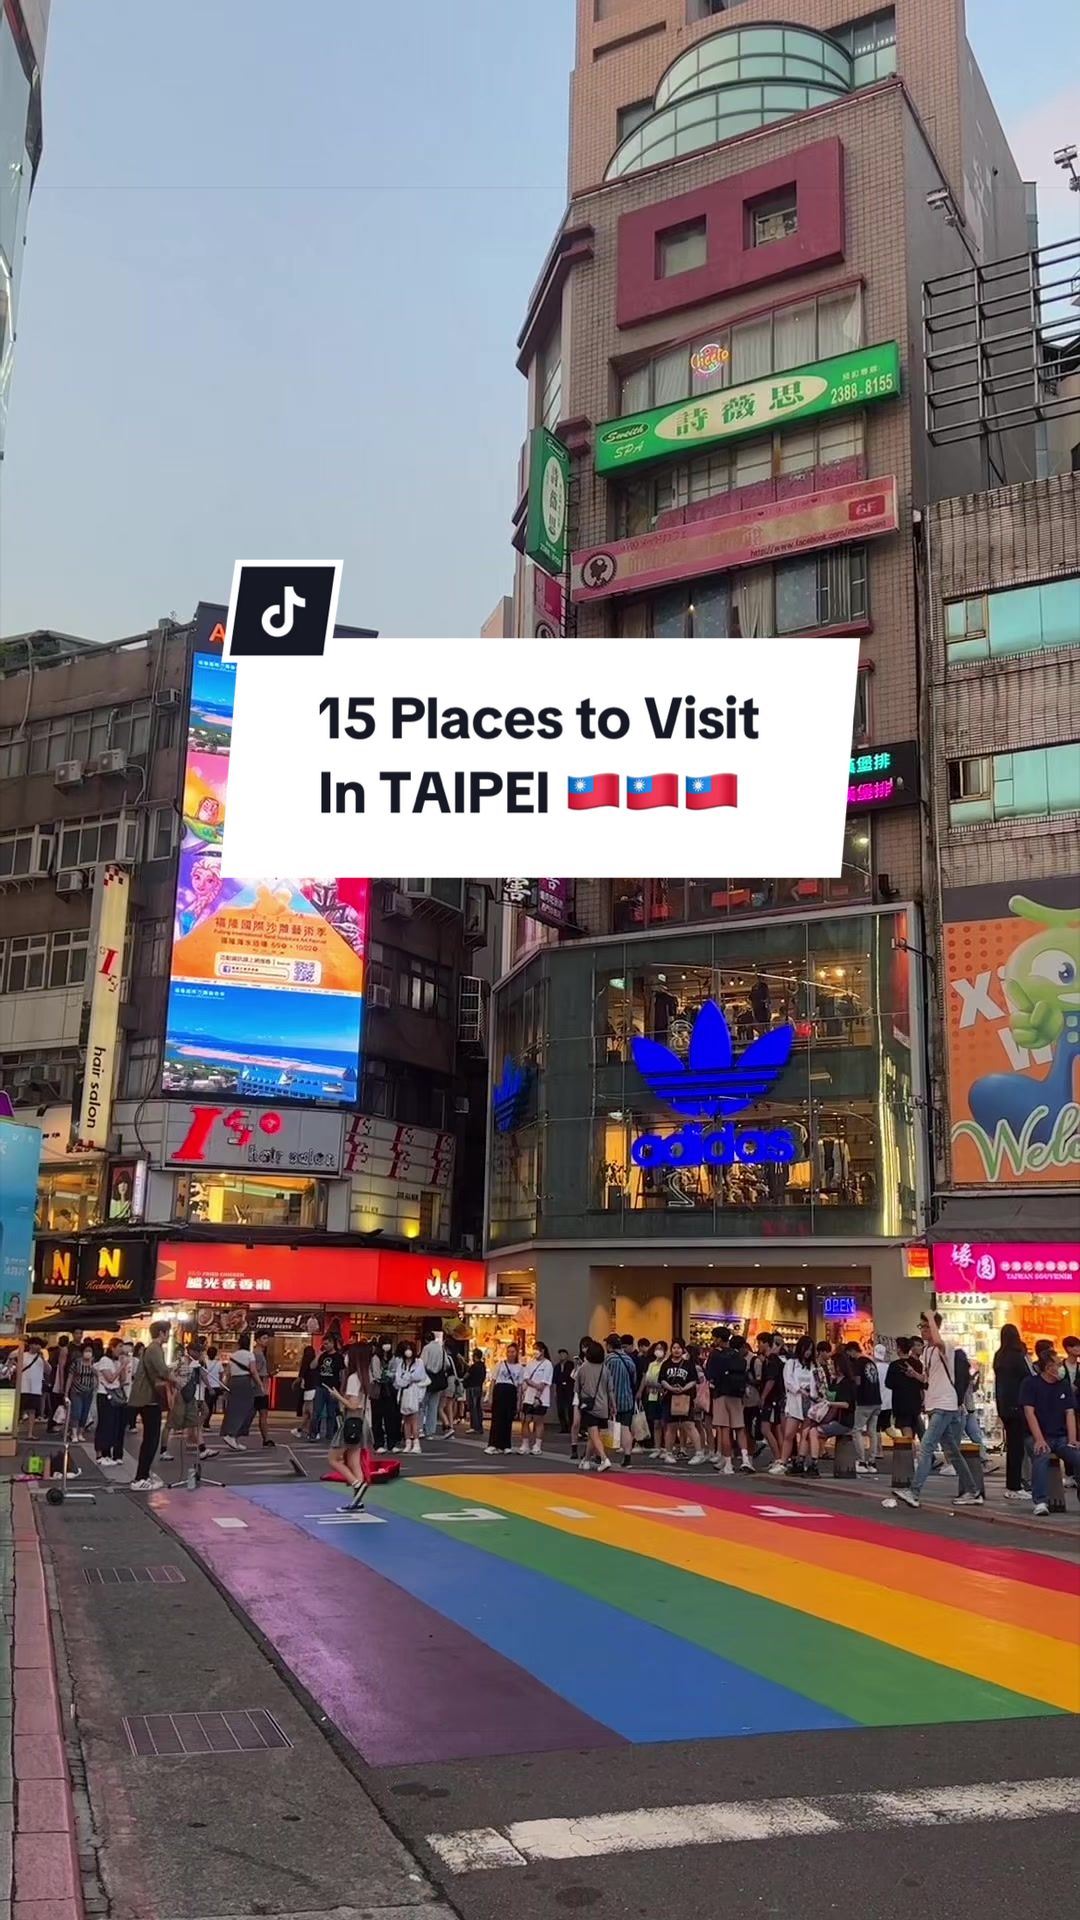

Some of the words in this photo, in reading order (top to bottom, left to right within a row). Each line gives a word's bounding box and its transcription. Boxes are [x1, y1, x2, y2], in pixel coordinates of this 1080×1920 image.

[831, 373, 893, 404] 2388-8155
[614, 440, 645, 459] SPA
[92, 1046, 106, 1079] hair
[86, 1081, 102, 1129] salon
[248, 1146, 282, 1166] hair
[289, 1150, 336, 1167] salon
[631, 1121, 796, 1168] adidas
[426, 1268, 463, 1299] J&G
[257, 1316, 284, 1324] TAIWAN
[824, 1298, 855, 1313] OPEN
